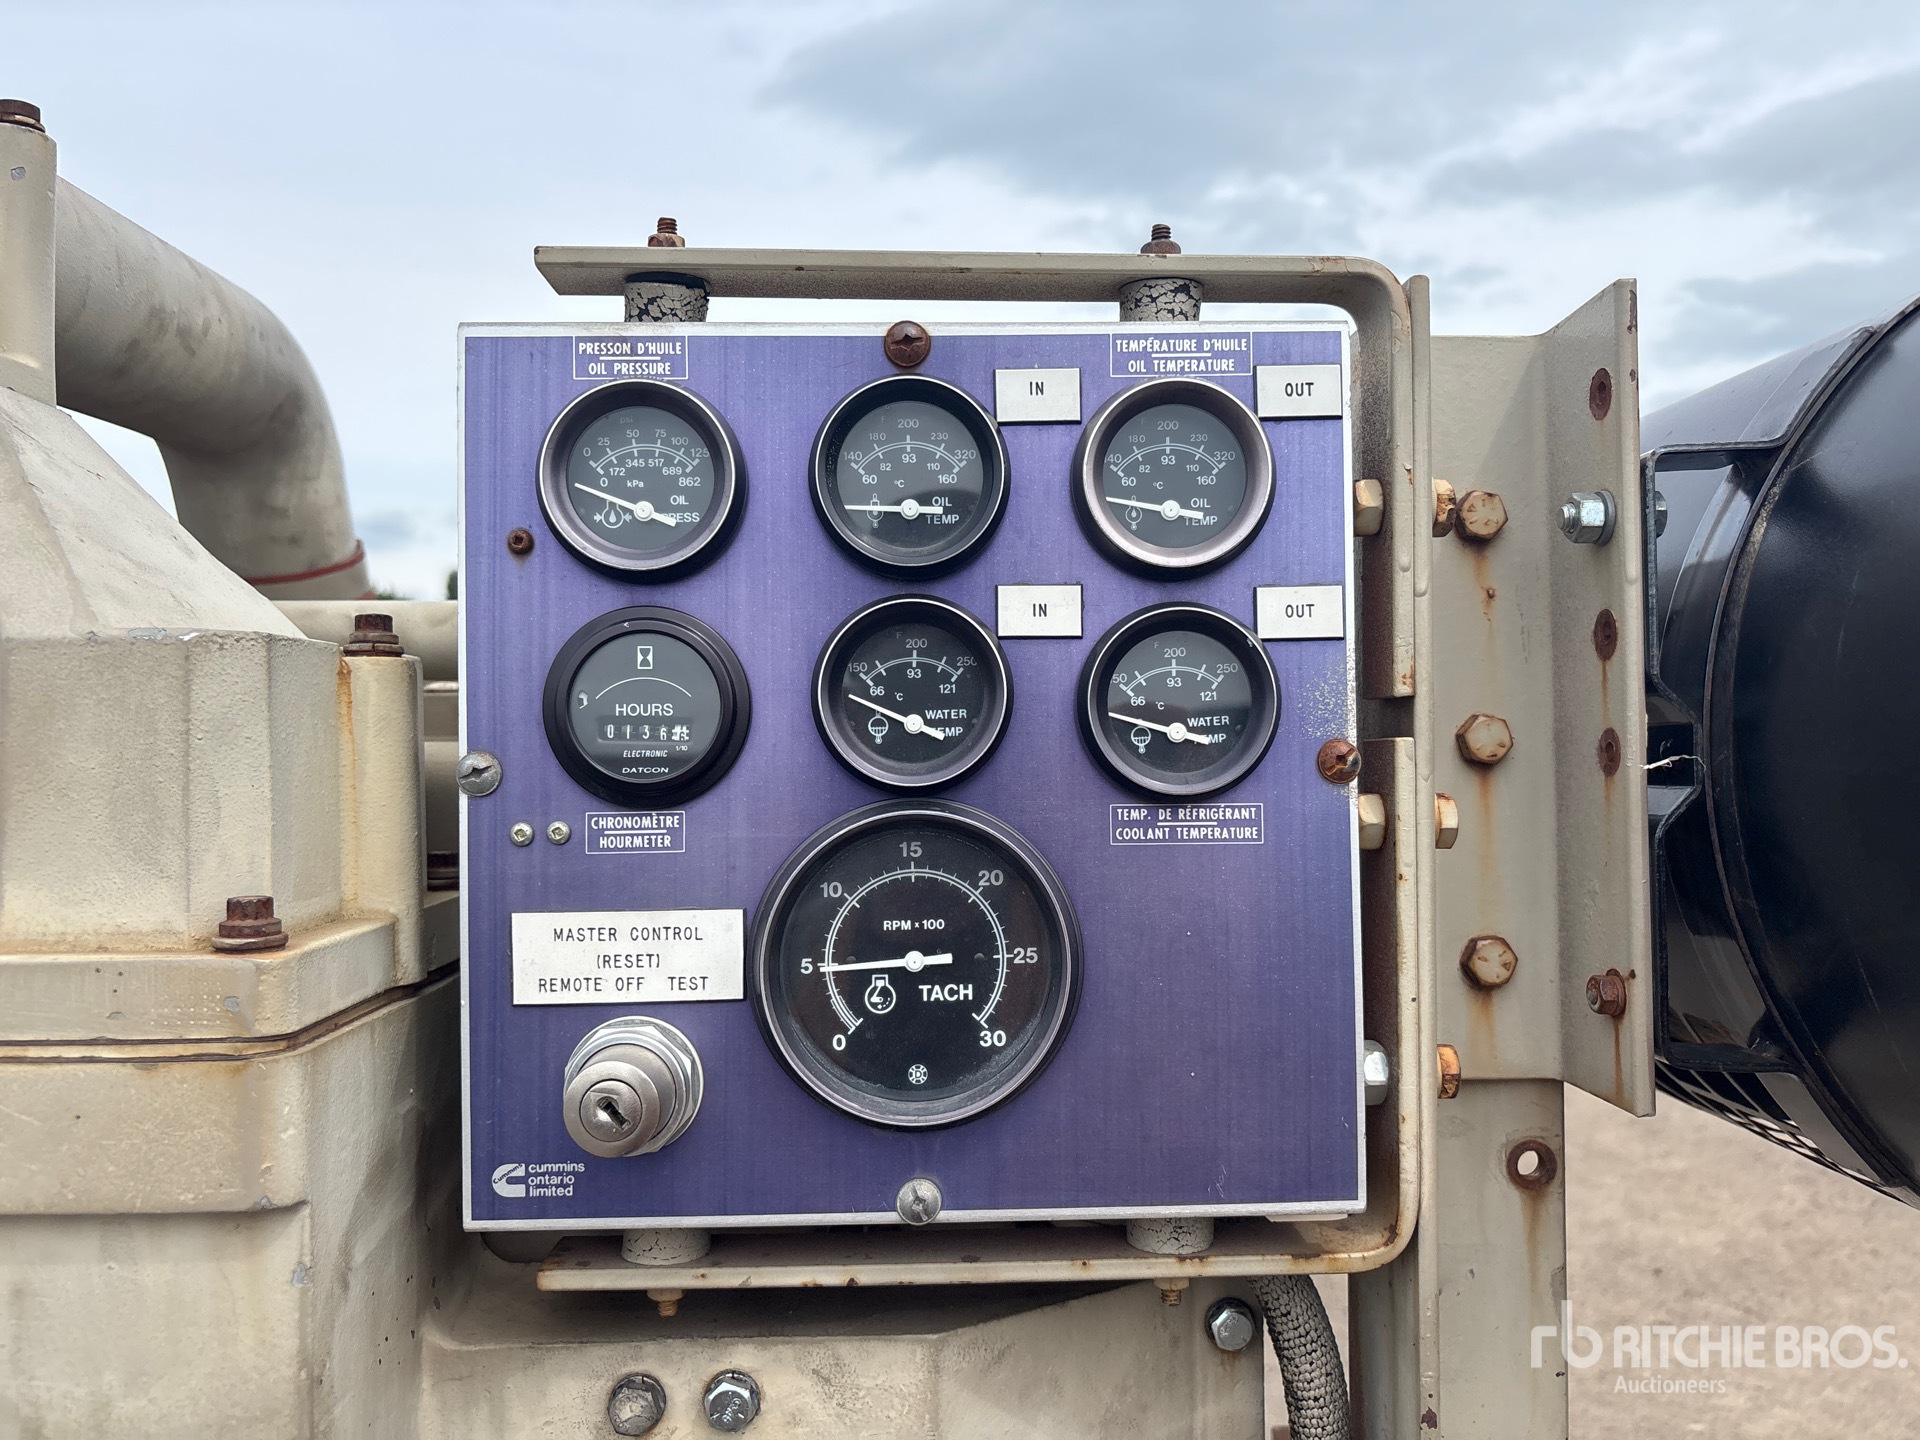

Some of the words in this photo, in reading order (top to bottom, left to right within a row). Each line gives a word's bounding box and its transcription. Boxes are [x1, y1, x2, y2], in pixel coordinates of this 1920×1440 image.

[579, 342, 631, 355] PRESSON
[637, 341, 682, 355] D'HUILE
[1115, 337, 1197, 352] TEMPÉRATURE
[1203, 338, 1247, 351] D'HUILE
[588, 363, 607, 375] OIL
[613, 362, 671, 375] PRESSURE
[1128, 360, 1147, 373] OIL
[1153, 359, 1235, 372] TEMPERATURE
[1029, 381, 1044, 396] IN
[1284, 382, 1315, 397] OUT
[619, 416, 634, 425] psi
[898, 418, 919, 429] 200
[1157, 420, 1179, 431] 200
[626, 429, 640, 438] 50
[654, 429, 667, 438] 75
[869, 432, 886, 441] 180
[930, 432, 948, 441] 230
[1129, 434, 1146, 443] 180
[1190, 434, 1208, 442] 230
[597, 437, 610, 446] 25
[670, 436, 688, 446] 100
[583, 448, 591, 457] 0
[690, 448, 709, 458] 125
[843, 451, 863, 461] 140
[902, 453, 917, 463] 93
[954, 450, 976, 460] 320
[1213, 451, 1236, 461] 320
[625, 458, 645, 468] 345
[648, 458, 664, 468] 517
[1161, 455, 1176, 465] 93
[662, 466, 682, 476] 689
[879, 462, 891, 471] 82
[926, 463, 940, 471] 110
[1138, 464, 1151, 473] 82
[1185, 464, 1199, 473] 110
[609, 468, 625, 477] 172
[599, 478, 608, 488] 0
[627, 479, 644, 488] kPa
[678, 477, 701, 487] 862
[862, 474, 877, 485] 60
[937, 474, 957, 484] 160
[1121, 476, 1137, 487] 60
[1196, 475, 1216, 486] 160
[670, 495, 689, 505] OIL
[932, 496, 952, 507] OIL
[1190, 497, 1211, 508] OIL
[925, 514, 960, 525] TEMP
[1184, 515, 1218, 526] TEMP
[1033, 603, 1047, 618] IN
[1285, 603, 1315, 618] OUT
[905, 638, 928, 649] 200
[1164, 647, 1186, 658] 200
[848, 662, 868, 672] 150
[1216, 663, 1238, 673] 250
[906, 668, 922, 678] 93
[1166, 677, 1182, 688] 93
[869, 686, 885, 696] 66
[938, 684, 956, 694] 121
[1130, 696, 1146, 706] 66
[1199, 691, 1217, 702] 121
[615, 703, 674, 717] HOURS
[925, 708, 967, 720] WATER
[1187, 715, 1229, 727] WATER
[623, 749, 669, 758] ELECTRONIC
[1116, 808, 1151, 821] TEMP.
[1158, 808, 1172, 820] DE
[1178, 804, 1257, 820] RÉFRIGÉRANT
[591, 813, 680, 829] CHRONOMÈTRE
[1115, 828, 1170, 840] COOLANT
[1176, 827, 1258, 840] TEMPERATURE
[599, 835, 671, 849] HOURMETER
[899, 841, 922, 857] 15
[978, 870, 1004, 887] 20
[820, 882, 842, 898] 10
[883, 920, 912, 931] RPM
[921, 919, 945, 930] 100
[553, 927, 618, 942] MASTER
[629, 926, 704, 941] CONTROL
[1013, 947, 1038, 964] 25
[596, 954, 661, 969] (RESET)
[800, 959, 813, 974] 5
[538, 977, 603, 992] REMOTE
[614, 976, 645, 992] OFF
[667, 976, 709, 991] TEST
[918, 983, 973, 1001] TACH
[832, 1033, 846, 1050] 0
[979, 1030, 1007, 1047] 30
[528, 1161, 585, 1173] cummins
[528, 1173, 575, 1185] ontario
[529, 1185, 573, 1197] limited
